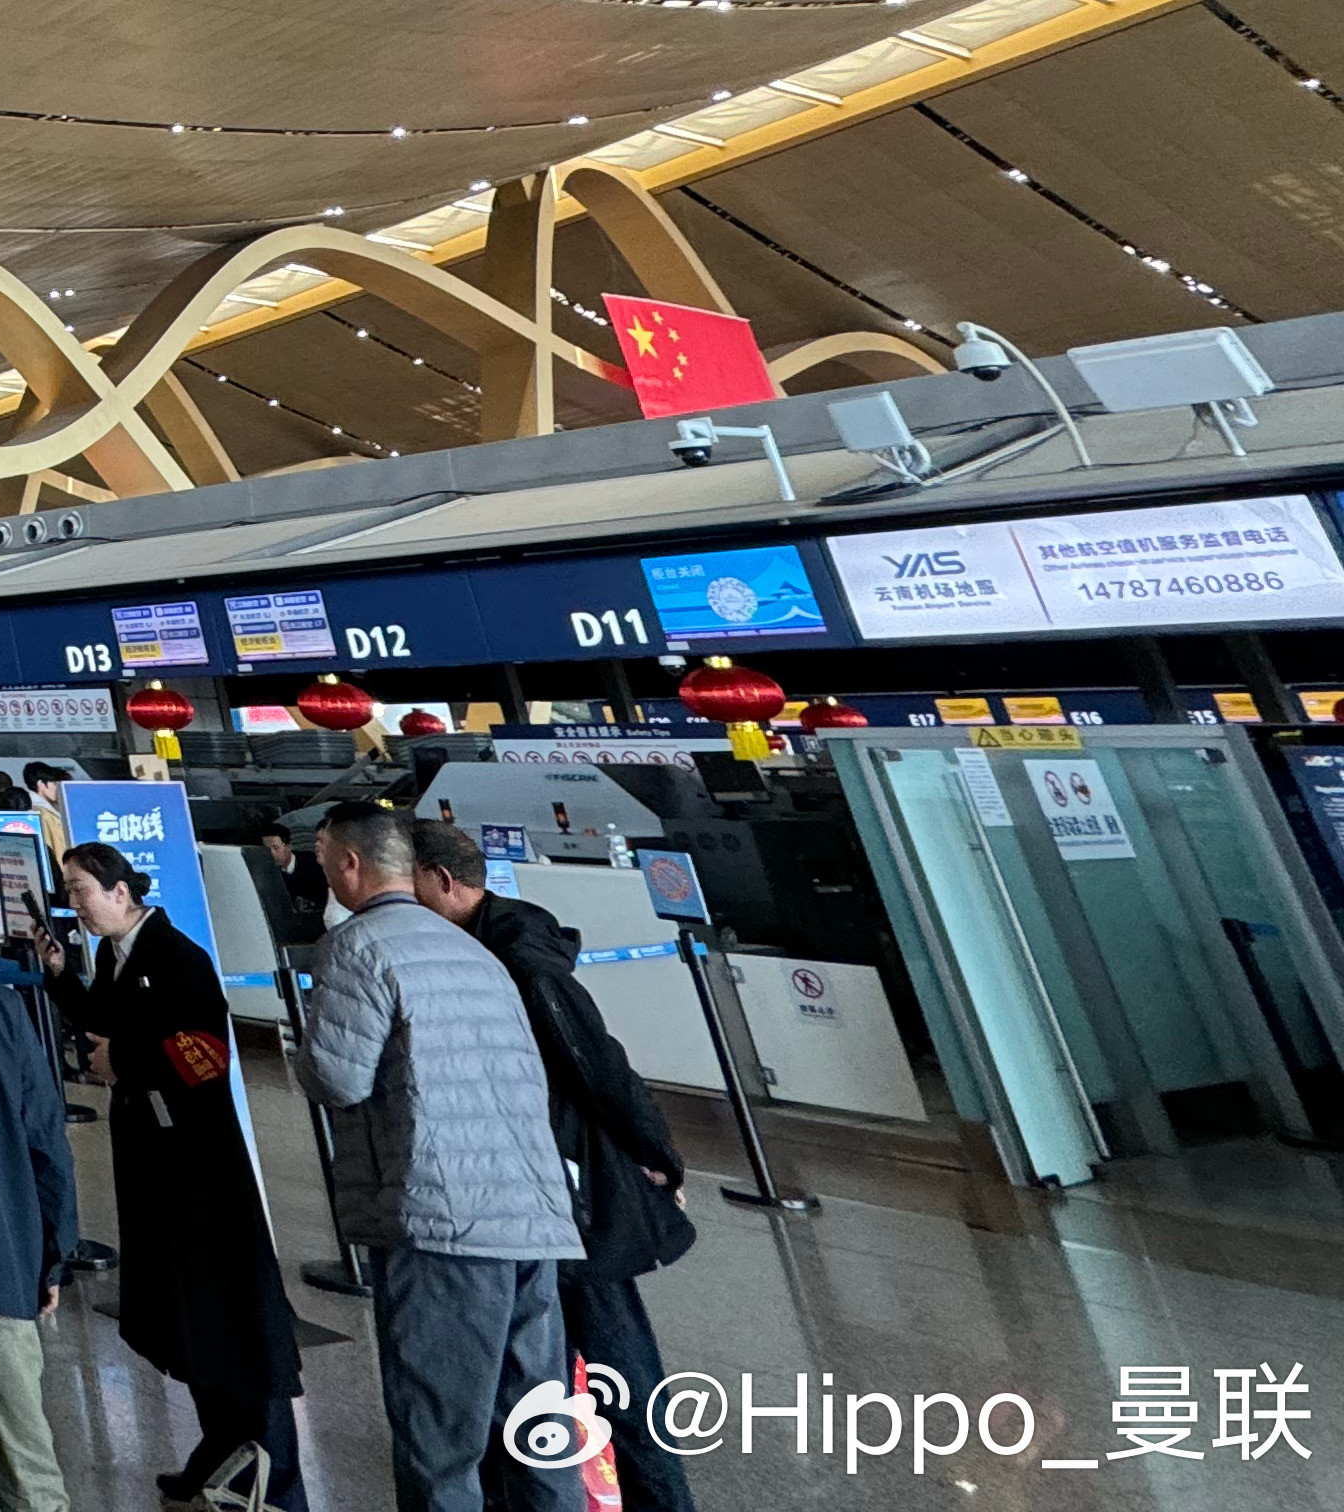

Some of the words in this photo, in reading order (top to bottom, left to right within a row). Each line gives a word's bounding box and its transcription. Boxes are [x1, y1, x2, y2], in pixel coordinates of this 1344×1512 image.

[1038, 526, 1290, 561] 其他航空值机服务监督电话
[882, 550, 966, 579] YAS
[875, 579, 999, 602] 云南机场地服
[1078, 572, 1285, 601] 14787460886
[345, 625, 411, 659] D12
[570, 608, 649, 647] D11
[65, 644, 113, 674] D13
[908, 713, 936, 726] E17
[1070, 711, 1103, 726] E16
[97, 806, 164, 843] 云快线
